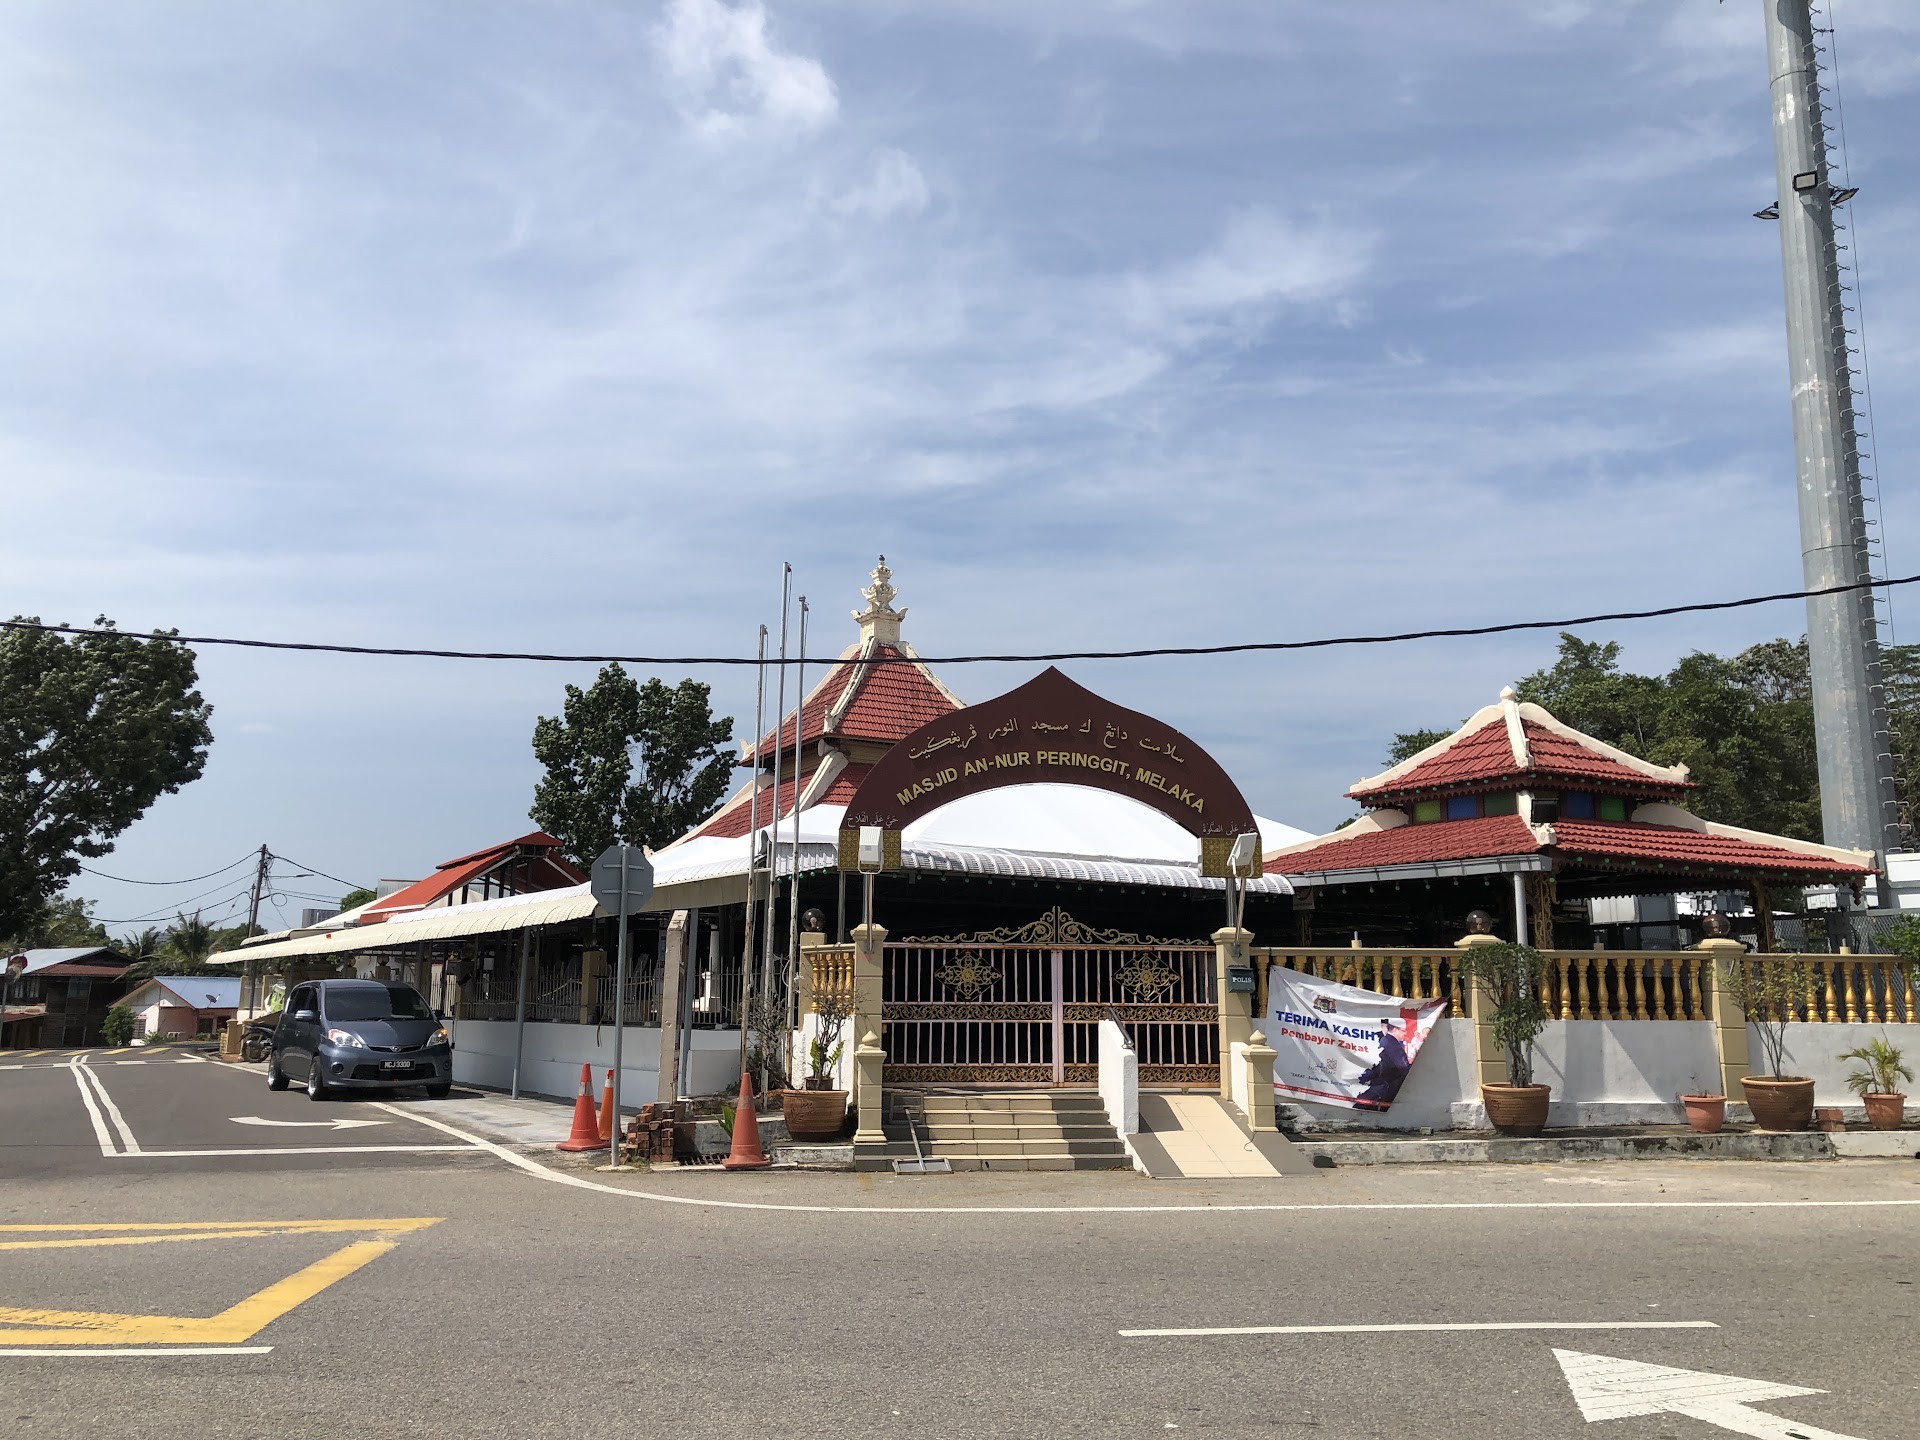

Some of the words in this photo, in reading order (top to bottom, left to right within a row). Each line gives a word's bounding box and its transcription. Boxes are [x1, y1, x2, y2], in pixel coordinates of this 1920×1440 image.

[896, 766, 959, 806] MASJID
[964, 751, 1031, 777] AN-NUR
[1036, 750, 1130, 779] PERINGGIT,
[1135, 767, 1205, 813] MELAKA
[1275, 1010, 1330, 1032] TERIMA
[1332, 1024, 1376, 1041] KASIH
[1281, 1027, 1336, 1046] Pembayar
[1337, 1039, 1369, 1053] Zakat
